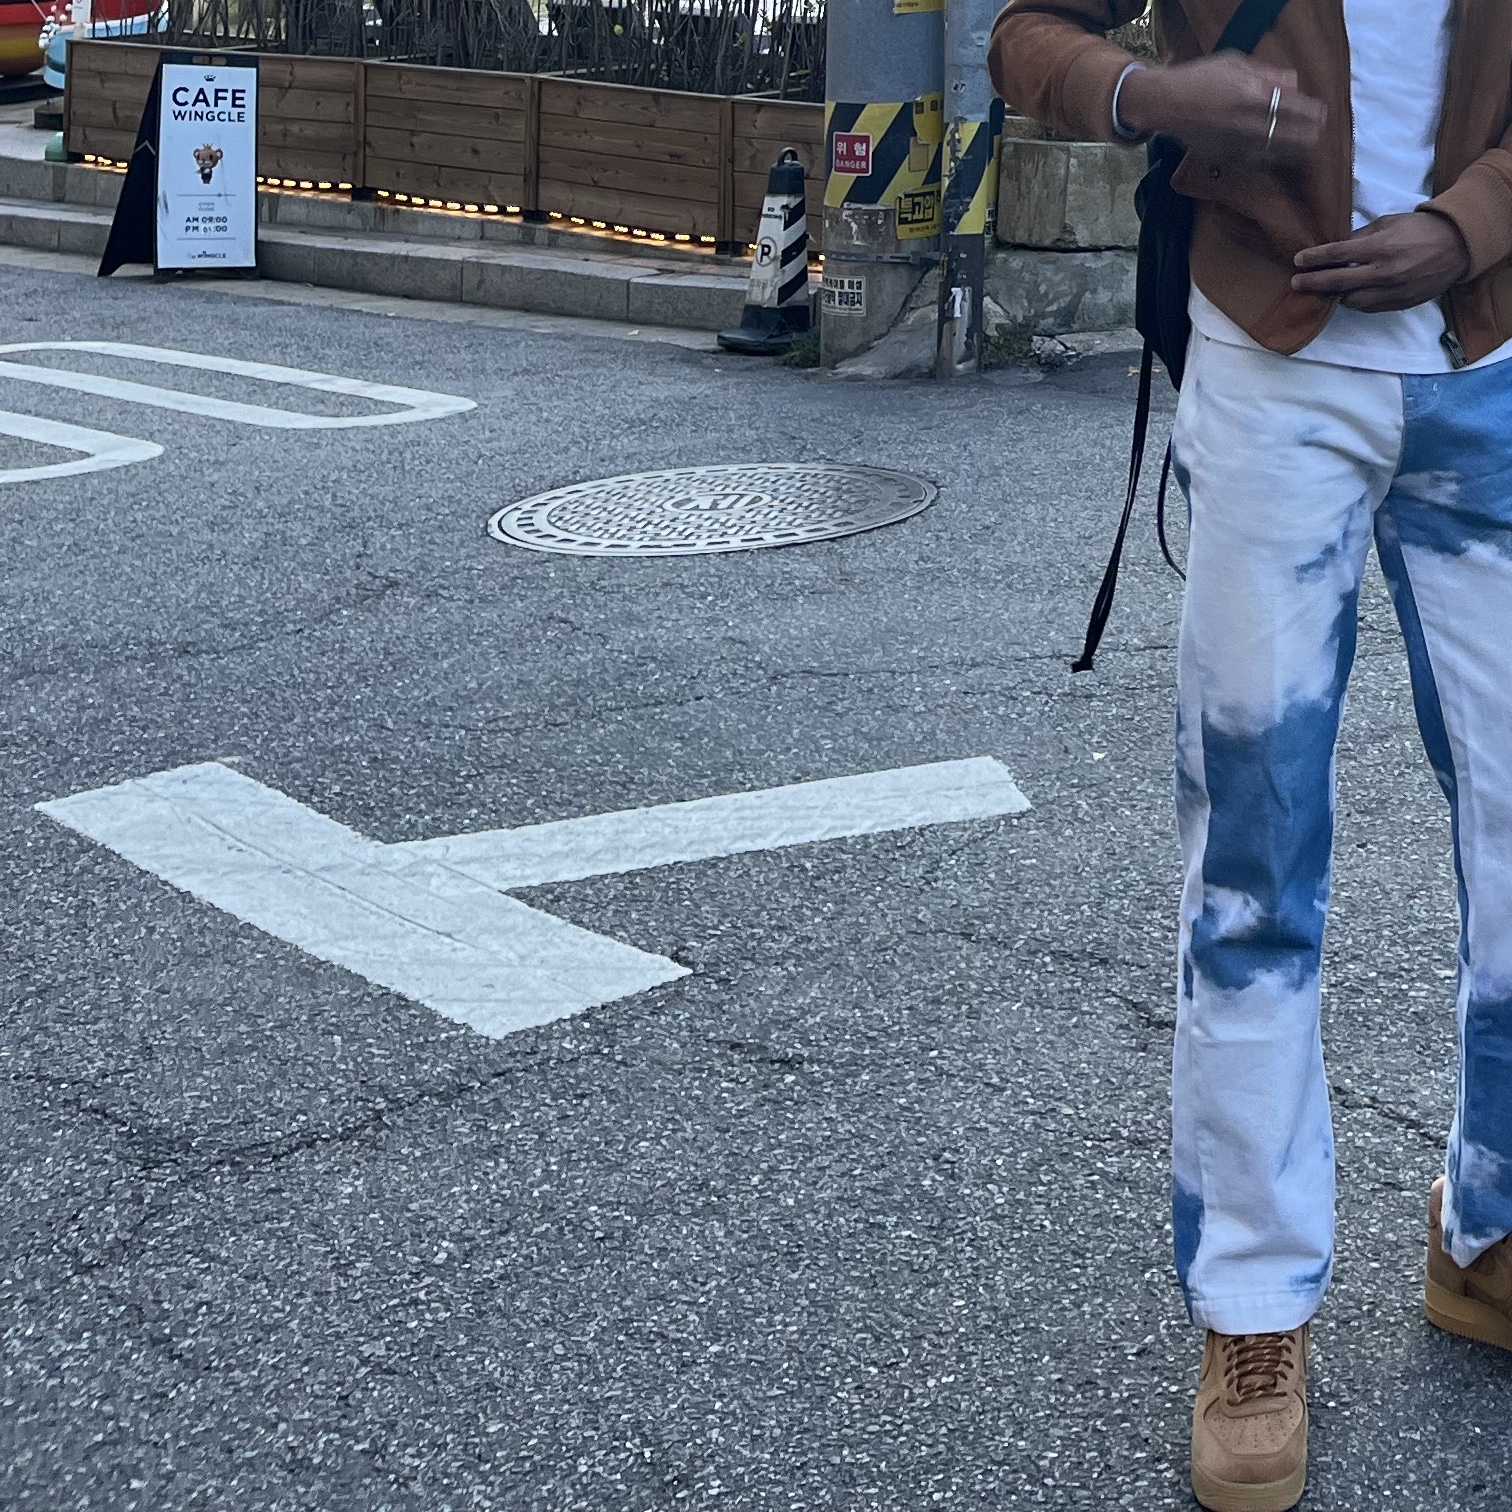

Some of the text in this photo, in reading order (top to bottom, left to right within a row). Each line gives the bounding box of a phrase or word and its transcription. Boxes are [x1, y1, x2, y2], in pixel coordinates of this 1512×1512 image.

[172, 86, 247, 109] CAFE
[172, 109, 246, 123] WINGCLE
[835, 159, 867, 170] DANGER
[185, 216, 200, 224] AM
[185, 225, 200, 233] PM
